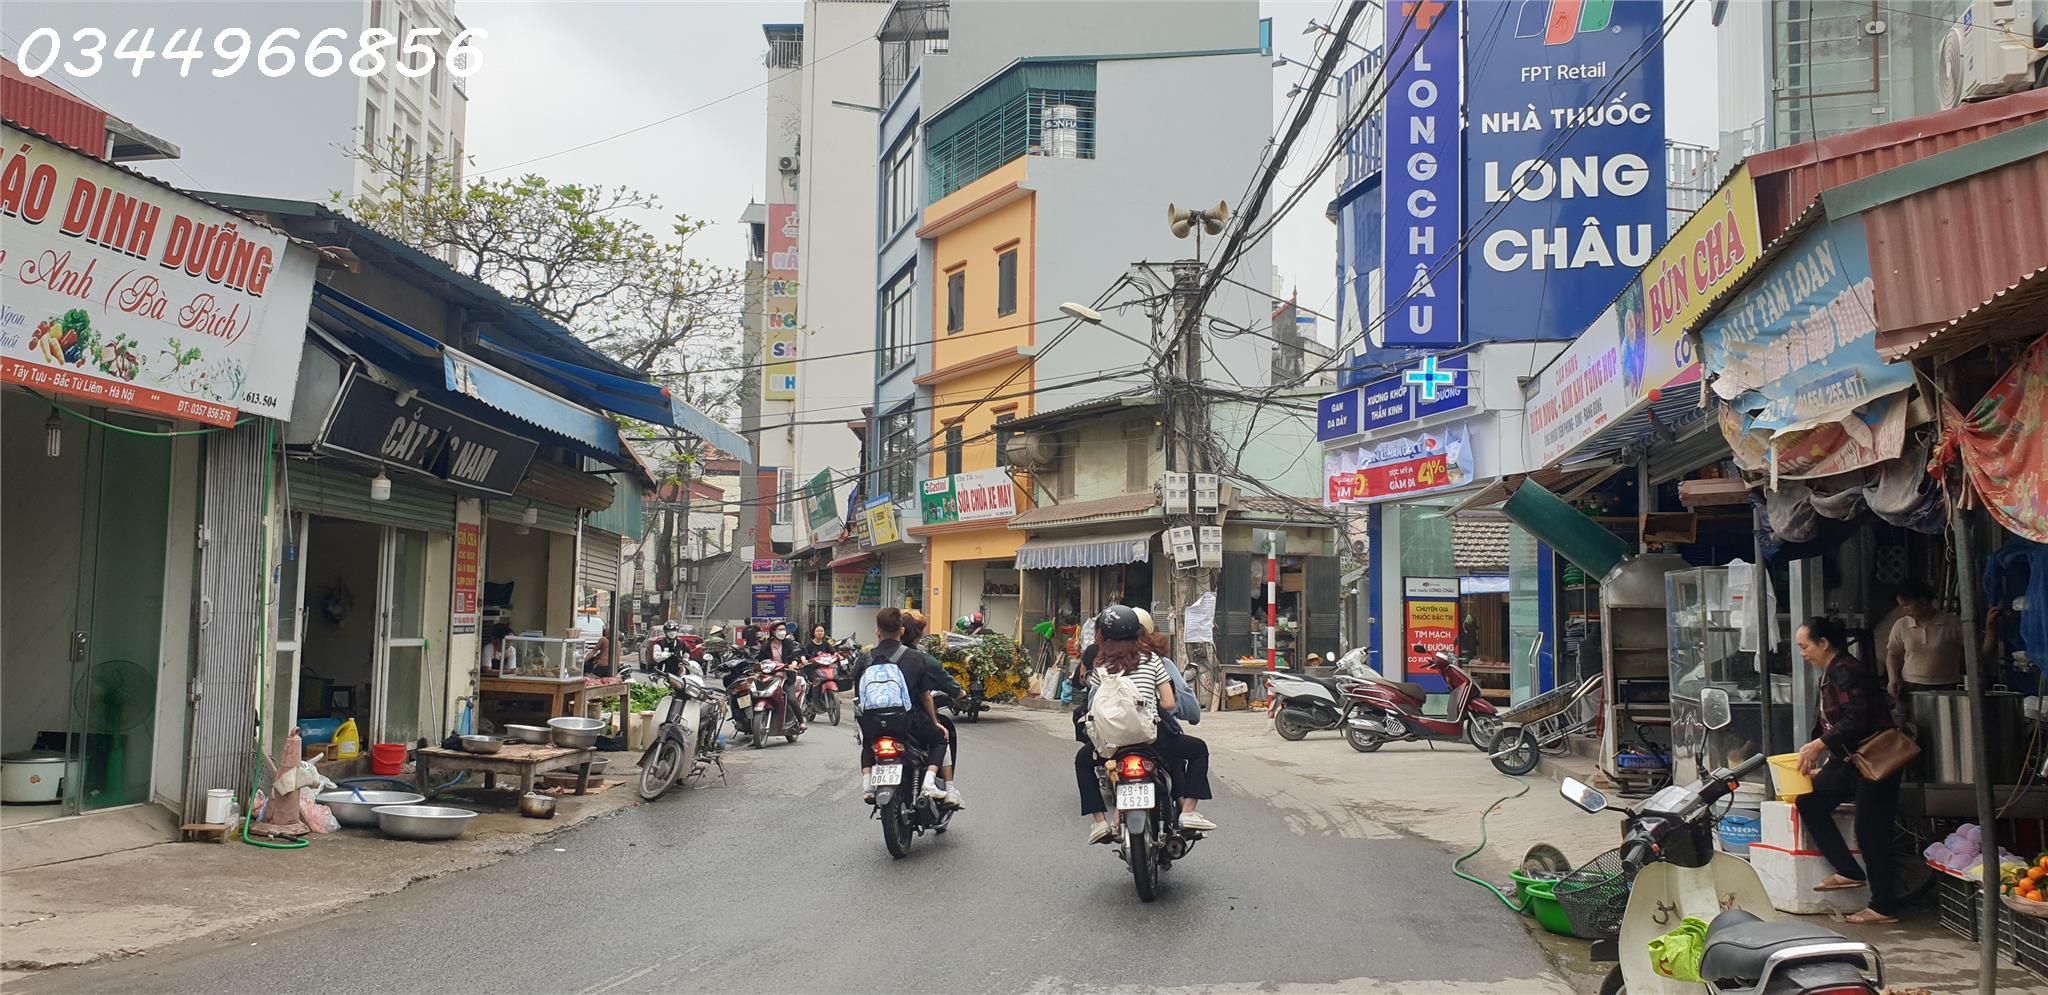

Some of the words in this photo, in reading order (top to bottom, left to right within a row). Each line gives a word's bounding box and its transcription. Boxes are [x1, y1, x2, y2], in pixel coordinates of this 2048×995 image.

[1521, 65, 1552, 82] FPT
[1557, 61, 1606, 80] Retail
[1481, 104, 1542, 134] NHÀ
[1551, 92, 1652, 129] THUỐC
[1484, 153, 1649, 203] LONG
[59, 176, 161, 260] DINH
[160, 215, 273, 298] DƯỠNG
[1483, 216, 1652, 272] CHÂU
[19, 249, 98, 300] Anh
[1649, 255, 1690, 336] BÚN
[1693, 187, 1746, 296] CHẢ
[1785, 239, 1836, 305] LOAN
[13, 364, 29, 380] Tây
[31, 368, 47, 384] Tựu
[53, 373, 70, 388] Bắc
[84, 380, 103, 394] Liêm
[109, 385, 119, 398] Hà
[121, 388, 135, 401] Nội
[1368, 391, 1389, 406] XƯƠNG
[1390, 386, 1408, 403] KHỚP
[177, 400, 190, 413] ĐT:
[1331, 402, 1343, 413] GAN
[1371, 406, 1388, 421] THẦN
[1387, 403, 1403, 417] KINH
[381, 406, 429, 461] CẮT
[451, 440, 499, 482] NAM
[929, 480, 947, 493] Castrol
[958, 483, 970, 513] SỬA
[970, 483, 987, 512] CHỮA
[988, 486, 997, 509] XE
[996, 479, 1012, 508] MÁY
[1411, 610, 1432, 620] THUỐC
[1414, 630, 1428, 638] TIM
[1429, 630, 1451, 640] MẠCH
[1122, 785, 1149, 796] 29-Y8
[1122, 796, 1149, 807] 4529
